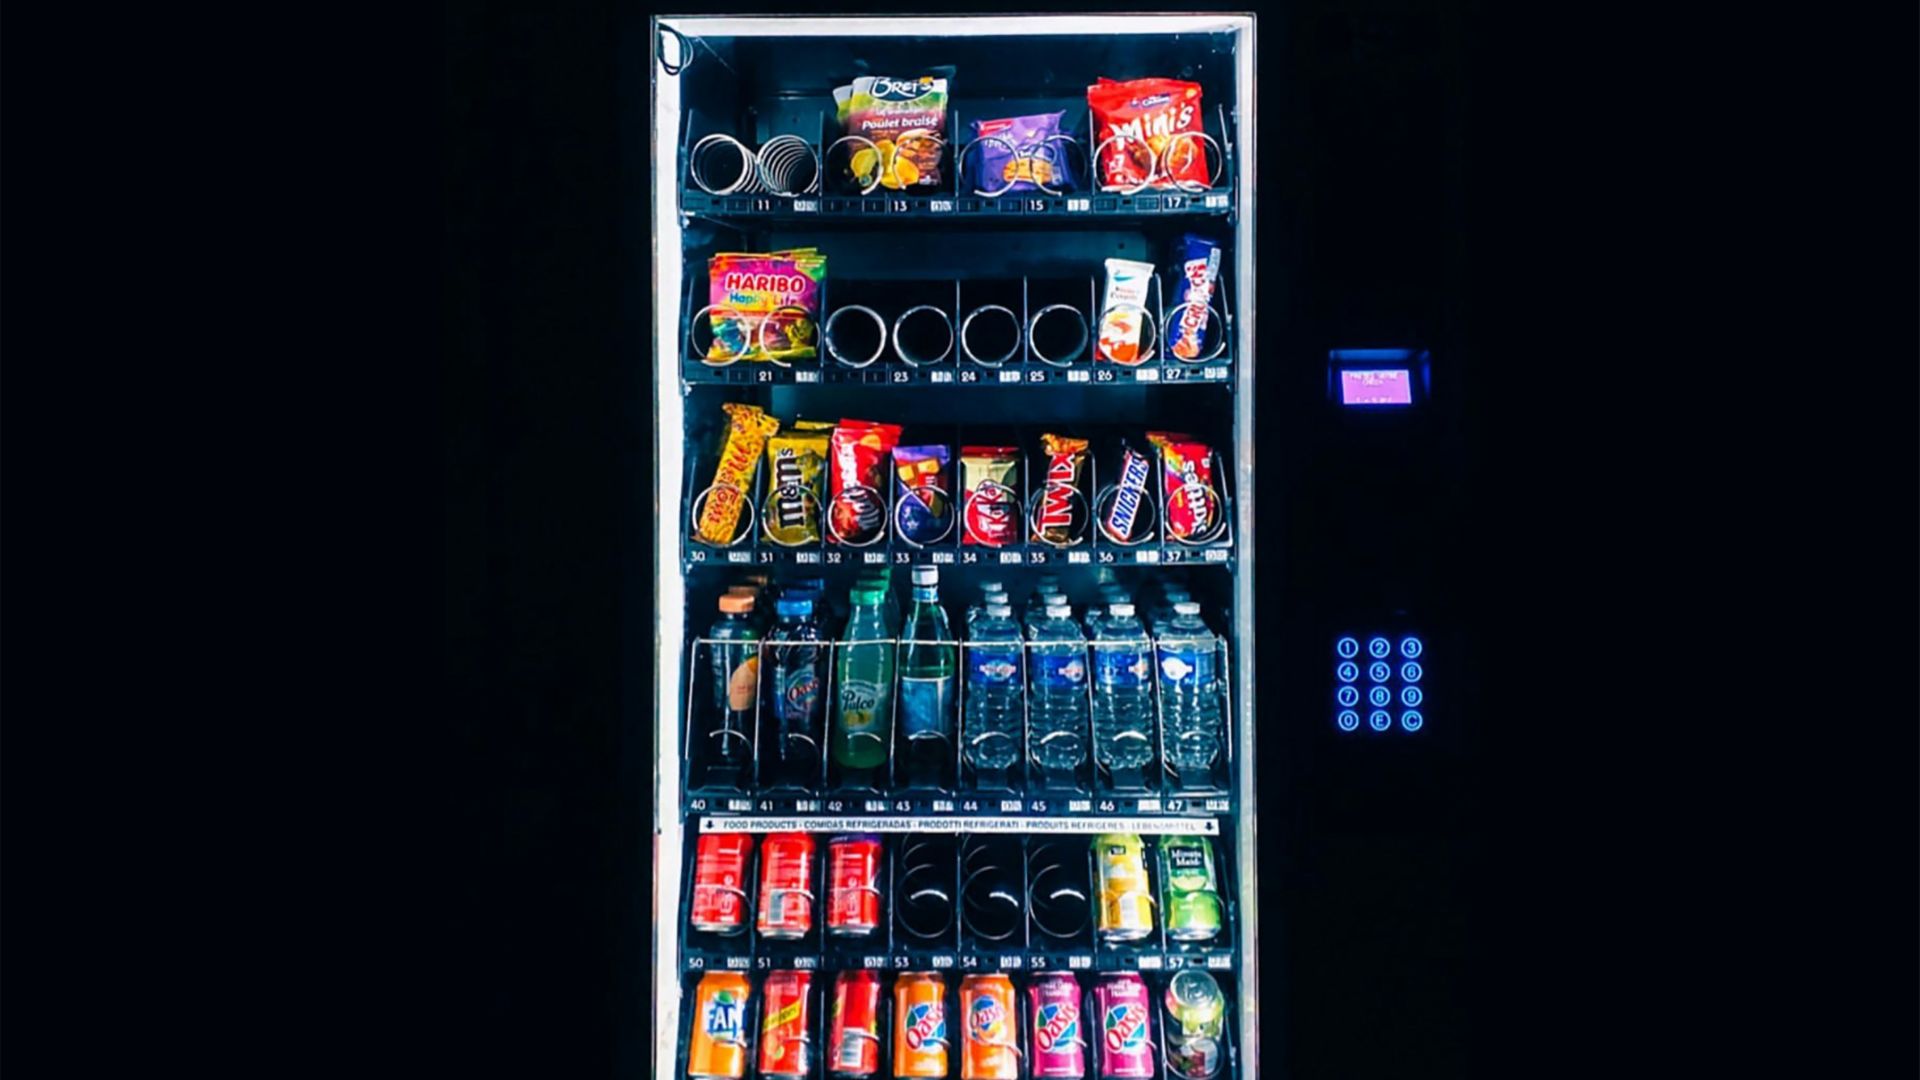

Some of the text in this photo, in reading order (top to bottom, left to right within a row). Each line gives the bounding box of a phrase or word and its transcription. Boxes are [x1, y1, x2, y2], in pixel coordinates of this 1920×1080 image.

[862, 113, 938, 131] Poulet braisé
[758, 199, 770, 211] 11
[894, 200, 908, 212] 13
[1030, 199, 1044, 211] 15
[1167, 196, 1181, 208] 17
[725, 273, 805, 293] HARIBO
[758, 370, 772, 382] 21
[893, 371, 909, 383] 23
[961, 371, 976, 383] 24
[1029, 370, 1045, 383] 25
[1097, 369, 1113, 381] 26
[1167, 368, 1182, 381] 27
[1039, 453, 1075, 536] TWIX
[690, 550, 706, 562] 30
[761, 552, 773, 563] 31
[827, 552, 841, 564] 32
[896, 552, 910, 564] 33
[963, 552, 977, 564] 34
[1031, 552, 1046, 564] 35
[1099, 551, 1114, 563] 36
[1167, 550, 1182, 563] 37
[690, 799, 706, 811] 40
[760, 800, 773, 811] 41
[827, 801, 843, 812] 42
[895, 800, 911, 812] 43
[963, 801, 978, 811] 44
[1031, 800, 1047, 812] 45
[1099, 800, 1115, 812] 46
[1167, 799, 1183, 812] 47
[723, 820, 749, 829] FOOD
[750, 820, 798, 829] PRODUCTS
[804, 820, 845, 829] COMIDAS
[846, 820, 912, 828] REFRIGERADAS
[918, 820, 962, 829] PRODOTTI
[1026, 820, 1070, 829] PRODUITS
[688, 957, 704, 969] 50
[757, 957, 771, 969] 51
[894, 956, 909, 968] 53
[962, 955, 977, 968] 54
[1031, 956, 1046, 968] 55
[1169, 956, 1183, 969] 57
[1037, 1004, 1078, 1051] Oasis
[1106, 1004, 1148, 1052] Oasis
